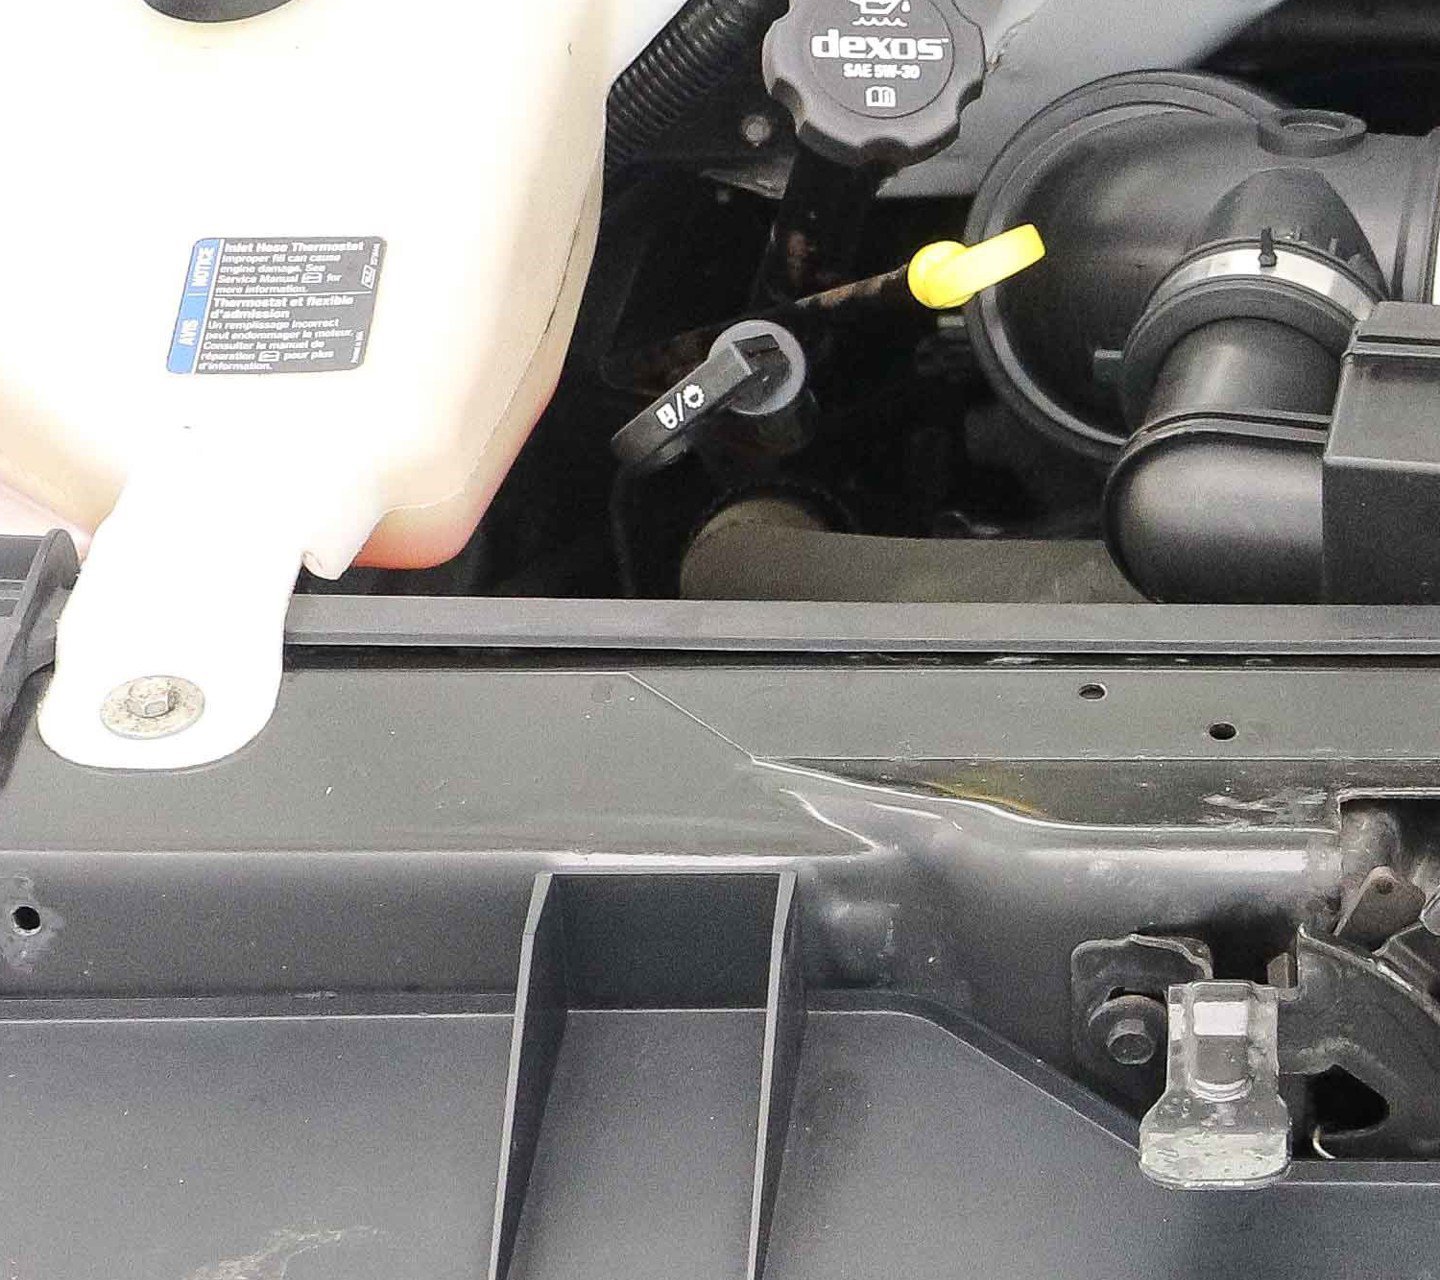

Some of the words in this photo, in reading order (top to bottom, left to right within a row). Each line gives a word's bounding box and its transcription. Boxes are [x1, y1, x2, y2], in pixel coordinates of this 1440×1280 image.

[842, 62, 873, 78] SAE
[873, 63, 921, 79] 5W-30
[224, 242, 254, 253] Inlet
[292, 241, 364, 252] Thermostat
[221, 254, 270, 265] Improper
[191, 247, 215, 287] NOTICE
[220, 265, 255, 275] engine
[216, 275, 258, 284] Service
[259, 274, 299, 283] Manual
[213, 297, 288, 308] Thermostat
